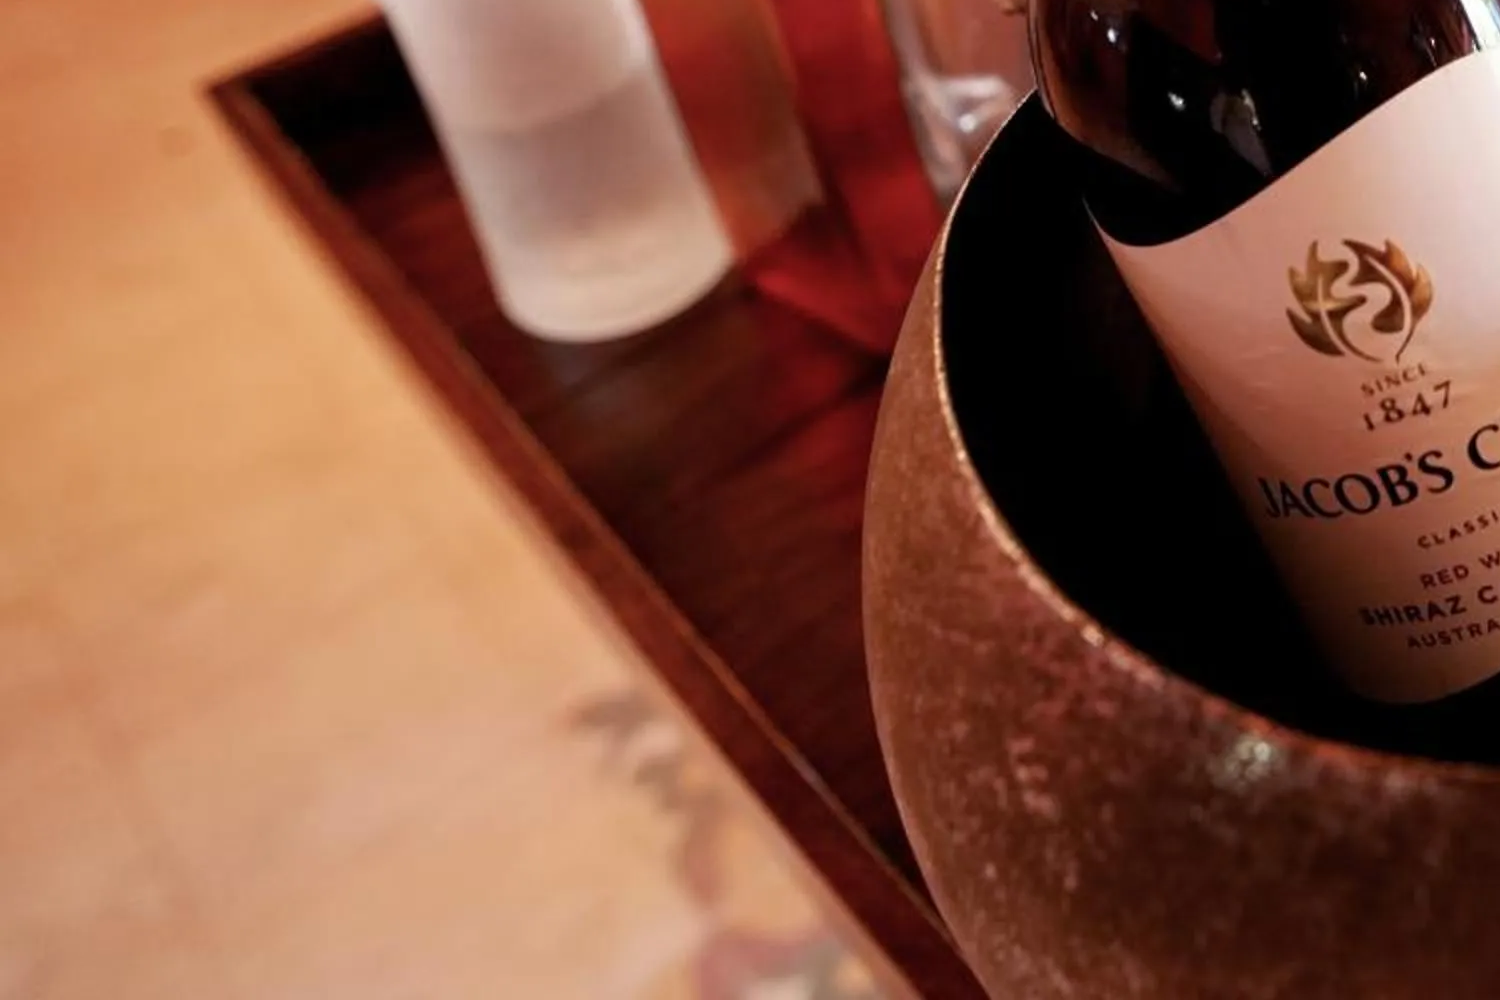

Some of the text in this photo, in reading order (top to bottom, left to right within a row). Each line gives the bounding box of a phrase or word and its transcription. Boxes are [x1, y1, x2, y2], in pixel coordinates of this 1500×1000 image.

[1361, 362, 1428, 397] SINCE
[1363, 379, 1451, 431] 1847
[1257, 448, 1455, 520] JACOB'S
[1420, 564, 1470, 590] RED
[1359, 594, 1468, 627] SHIRAZ
